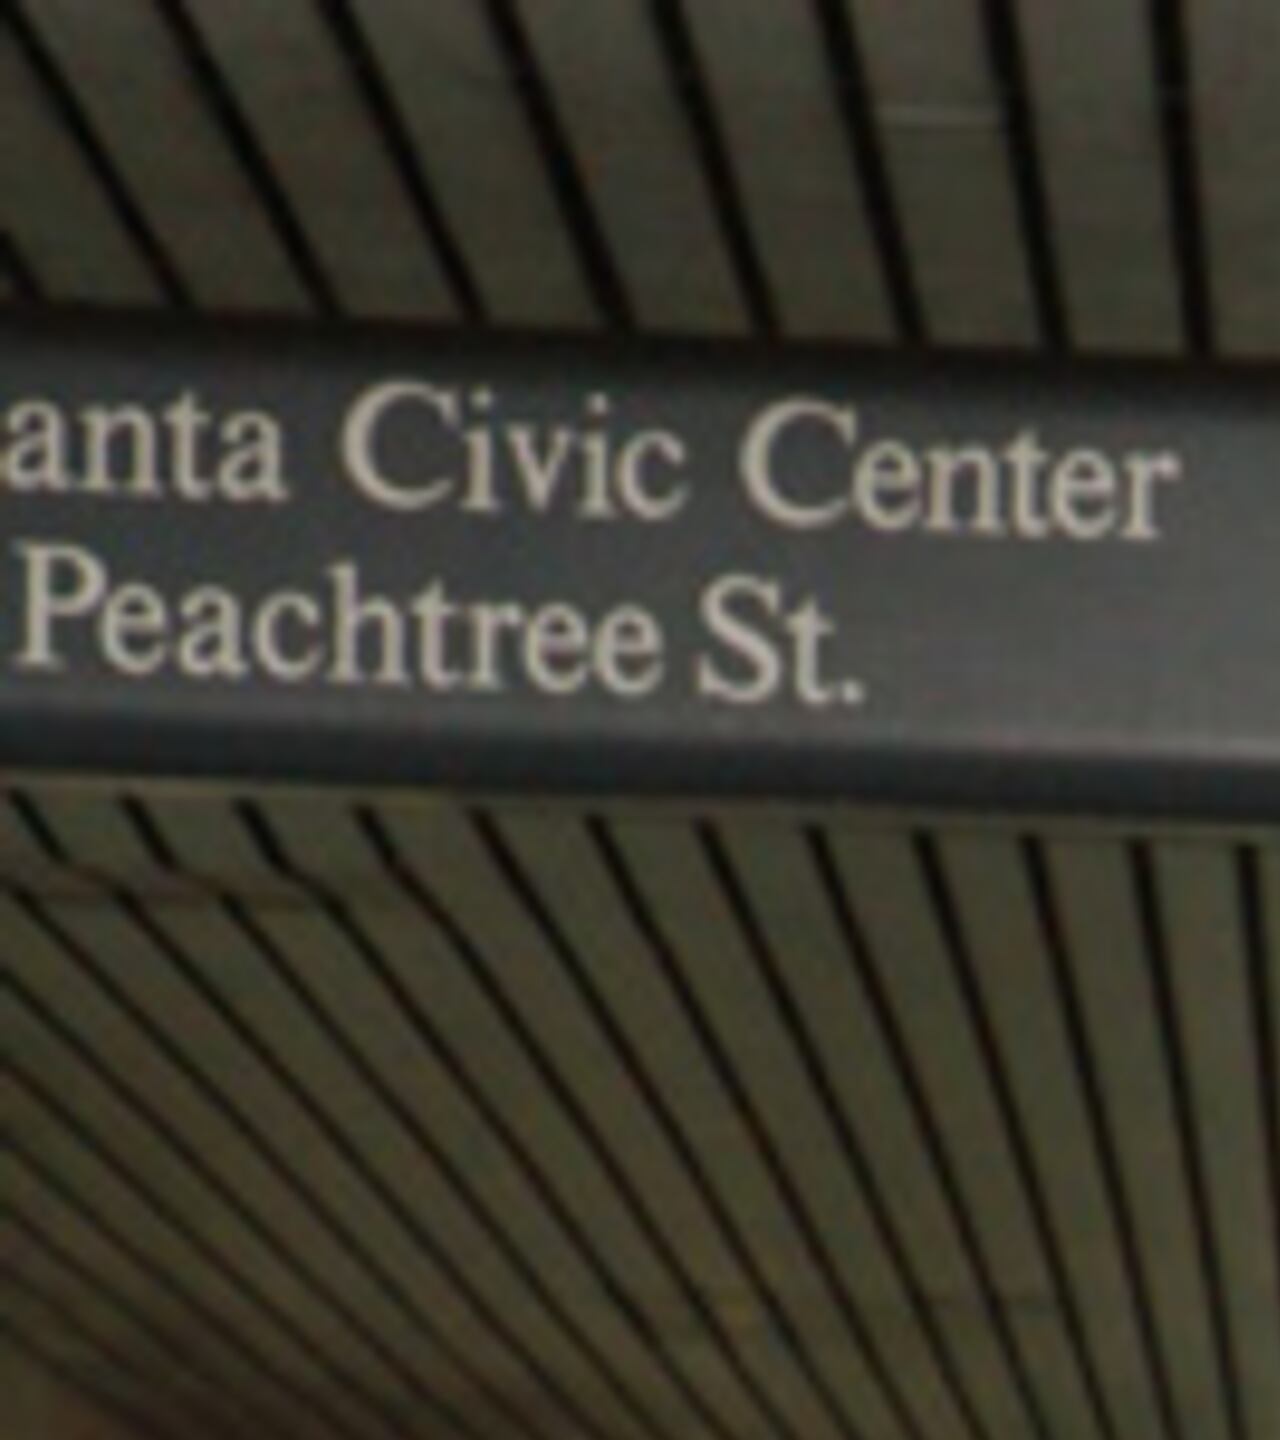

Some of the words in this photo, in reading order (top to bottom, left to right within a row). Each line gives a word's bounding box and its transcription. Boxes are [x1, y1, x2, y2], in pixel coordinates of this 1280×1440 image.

[0, 391, 289, 502] anta
[341, 376, 690, 519] Civic
[737, 394, 1180, 540] Center
[14, 538, 664, 696] Peachtree
[696, 571, 864, 706] St.
